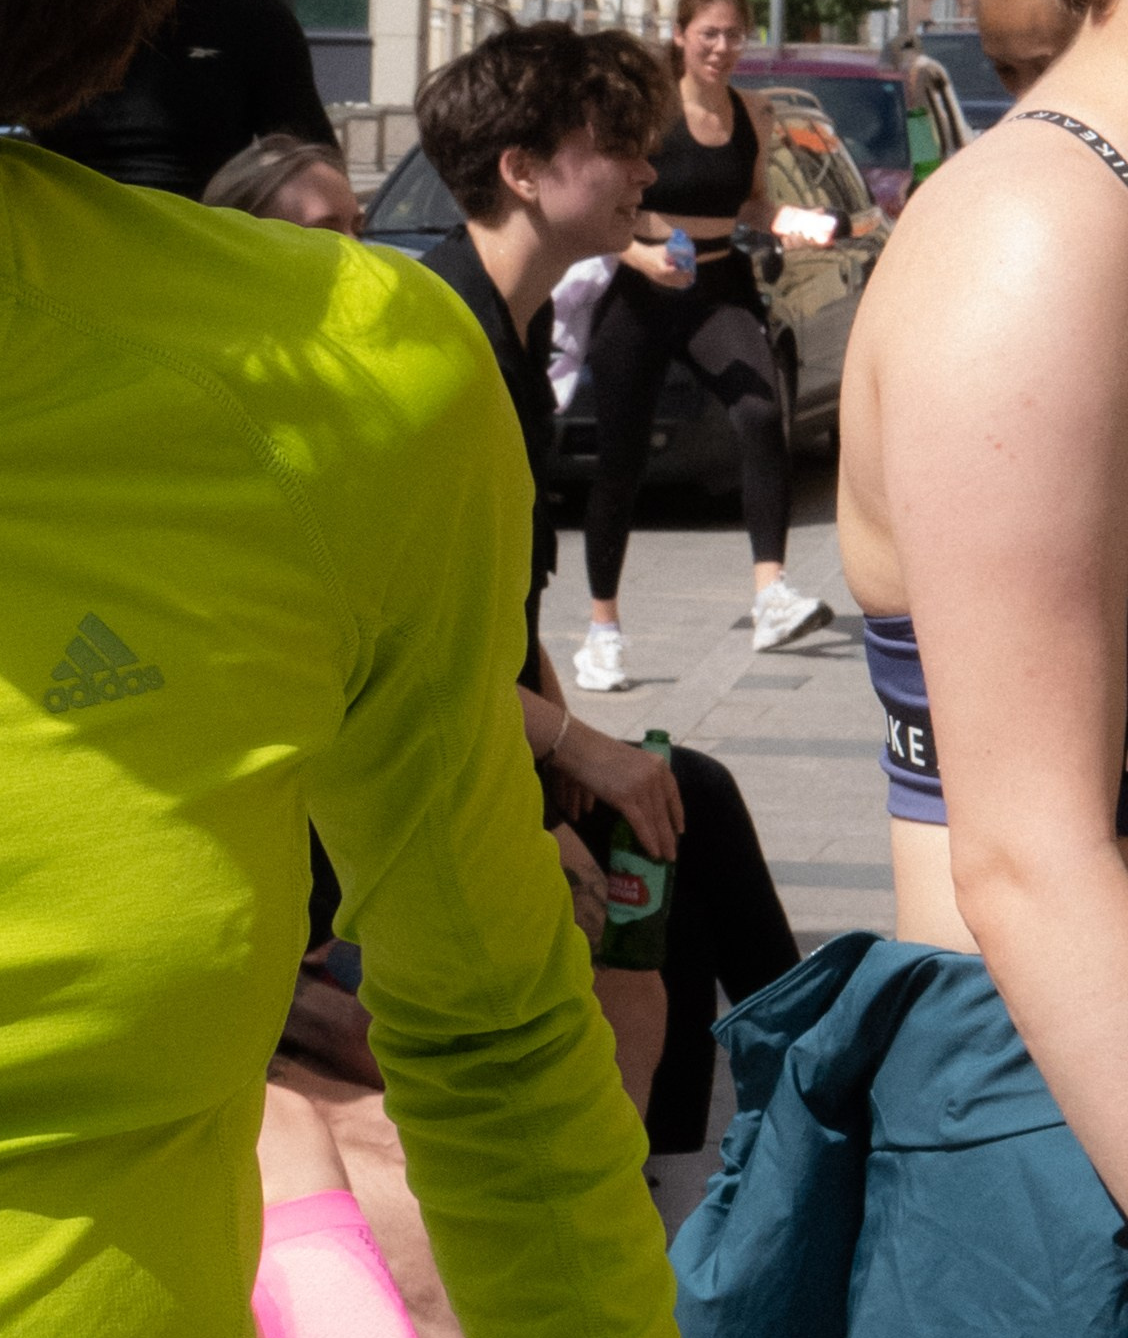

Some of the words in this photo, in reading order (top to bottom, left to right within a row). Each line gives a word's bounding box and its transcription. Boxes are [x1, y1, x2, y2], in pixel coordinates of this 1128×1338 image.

[1079, 130, 1128, 177] IKE
[44, 665, 165, 714] adidas
[885, 715, 925, 767] IKE
